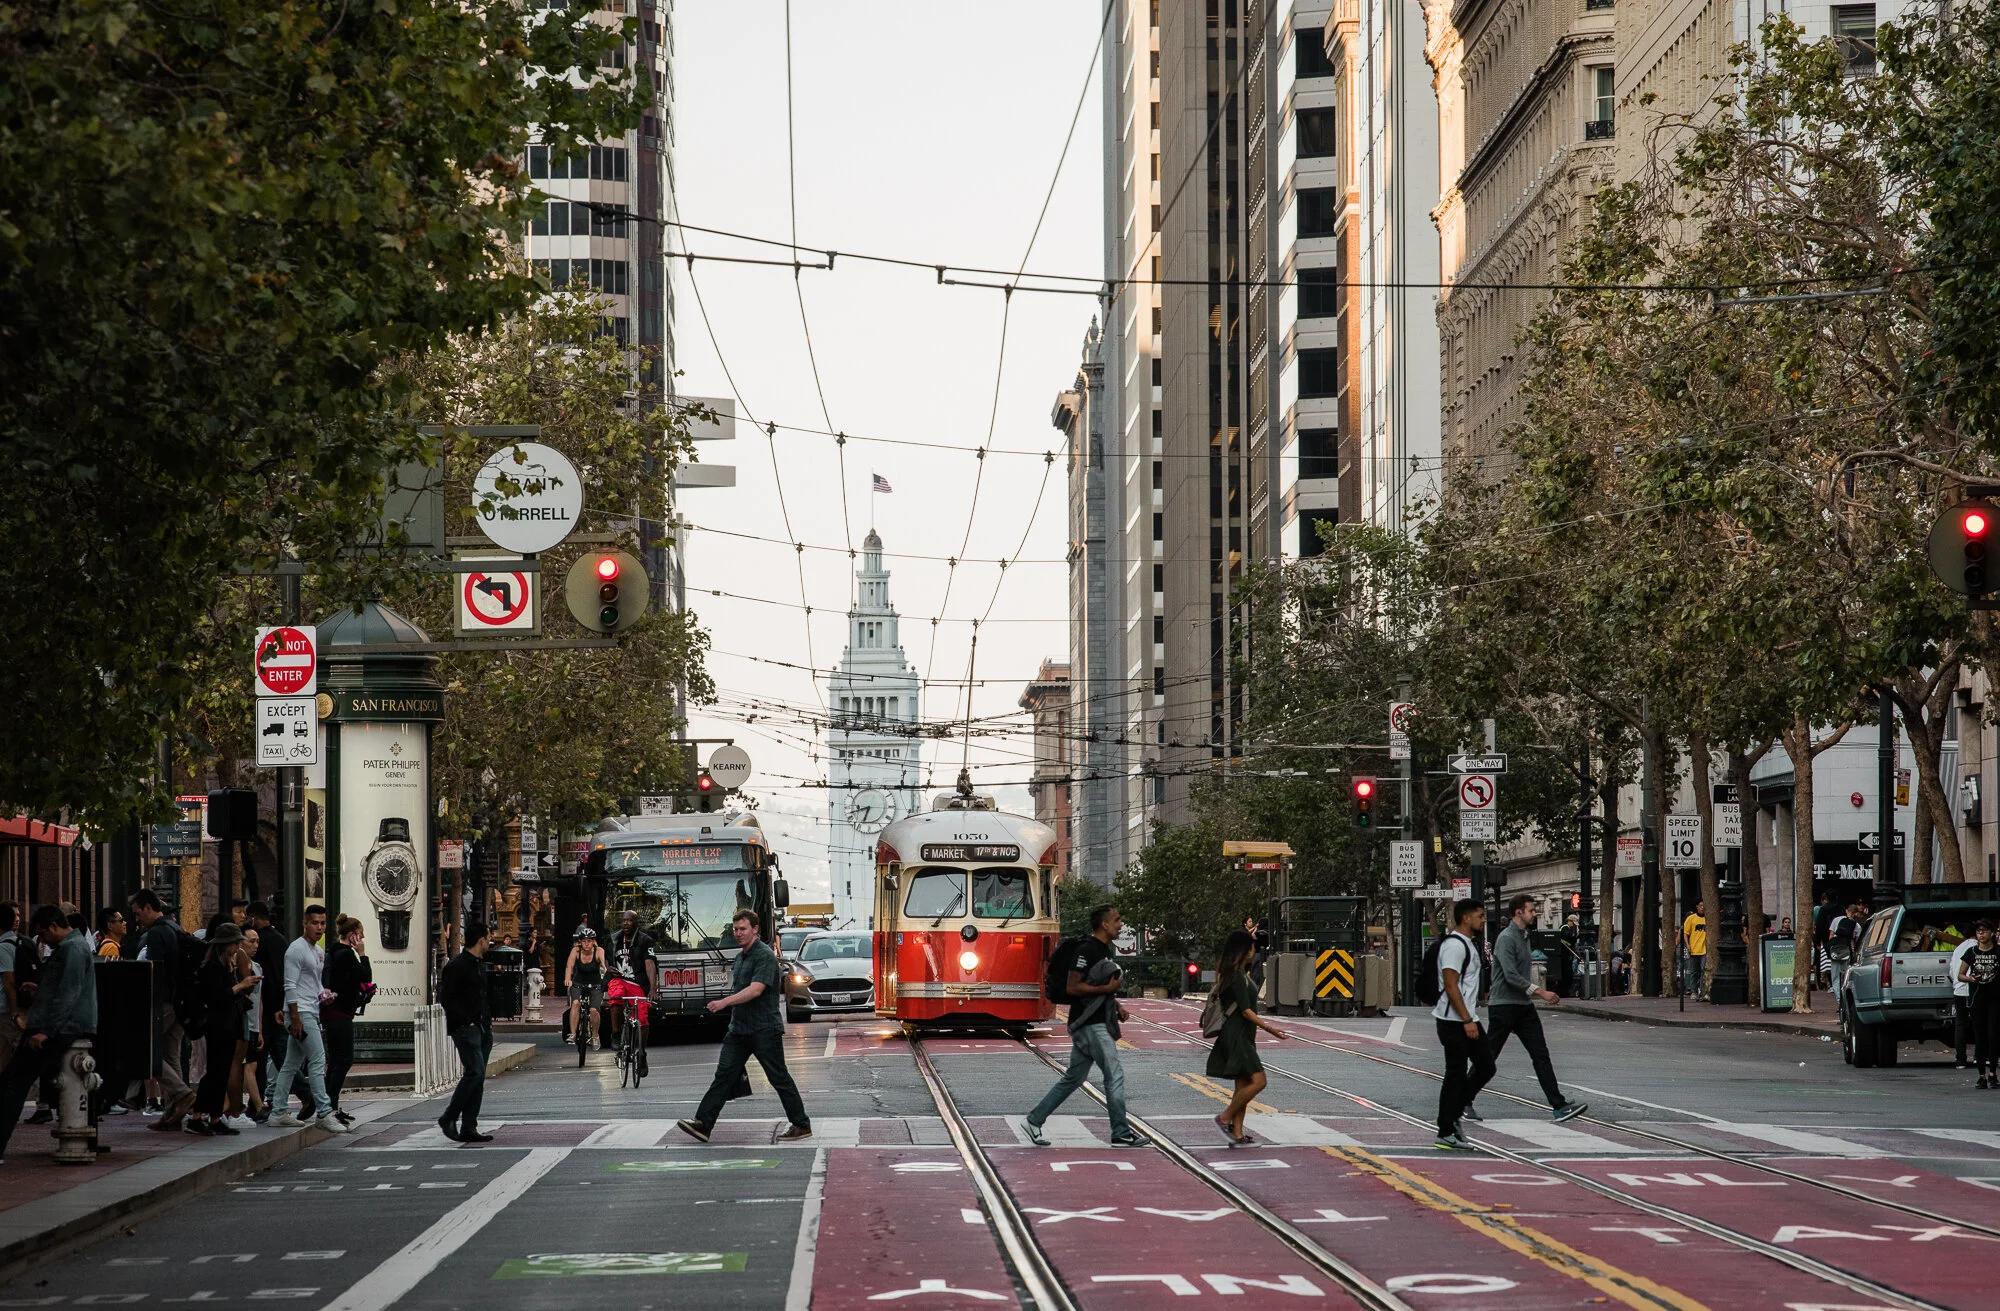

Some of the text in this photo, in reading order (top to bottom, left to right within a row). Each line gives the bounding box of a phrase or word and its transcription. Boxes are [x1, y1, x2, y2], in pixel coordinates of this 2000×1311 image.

[286, 640, 306, 651] NOT
[269, 670, 303, 682] ENTER
[267, 705, 306, 717] EXCEPT
[352, 699, 438, 712] SAN FRANCISCO
[363, 760, 420, 769] PATEK PHILIPPE
[713, 763, 746, 771] KEARNY
[1465, 760, 1500, 768] ONE WAY
[1668, 819, 1699, 827] SPEED
[167, 835, 182, 843] Union
[662, 849, 701, 859] NORIEGA
[704, 848, 721, 858] EXP
[924, 849, 929, 859] F
[931, 849, 964, 859] MARKET
[992, 848, 999, 857] &
[1000, 848, 1017, 857] NOE
[1672, 840, 1694, 857] 10
[664, 969, 698, 985] MUNI
[402, 987, 409, 996] &
[890, 1159, 1291, 1172] BUS
[1471, 1171, 1922, 1188] ONLY
[229, 1181, 470, 1193] STOP
[961, 1206, 1392, 1224] TAXI
